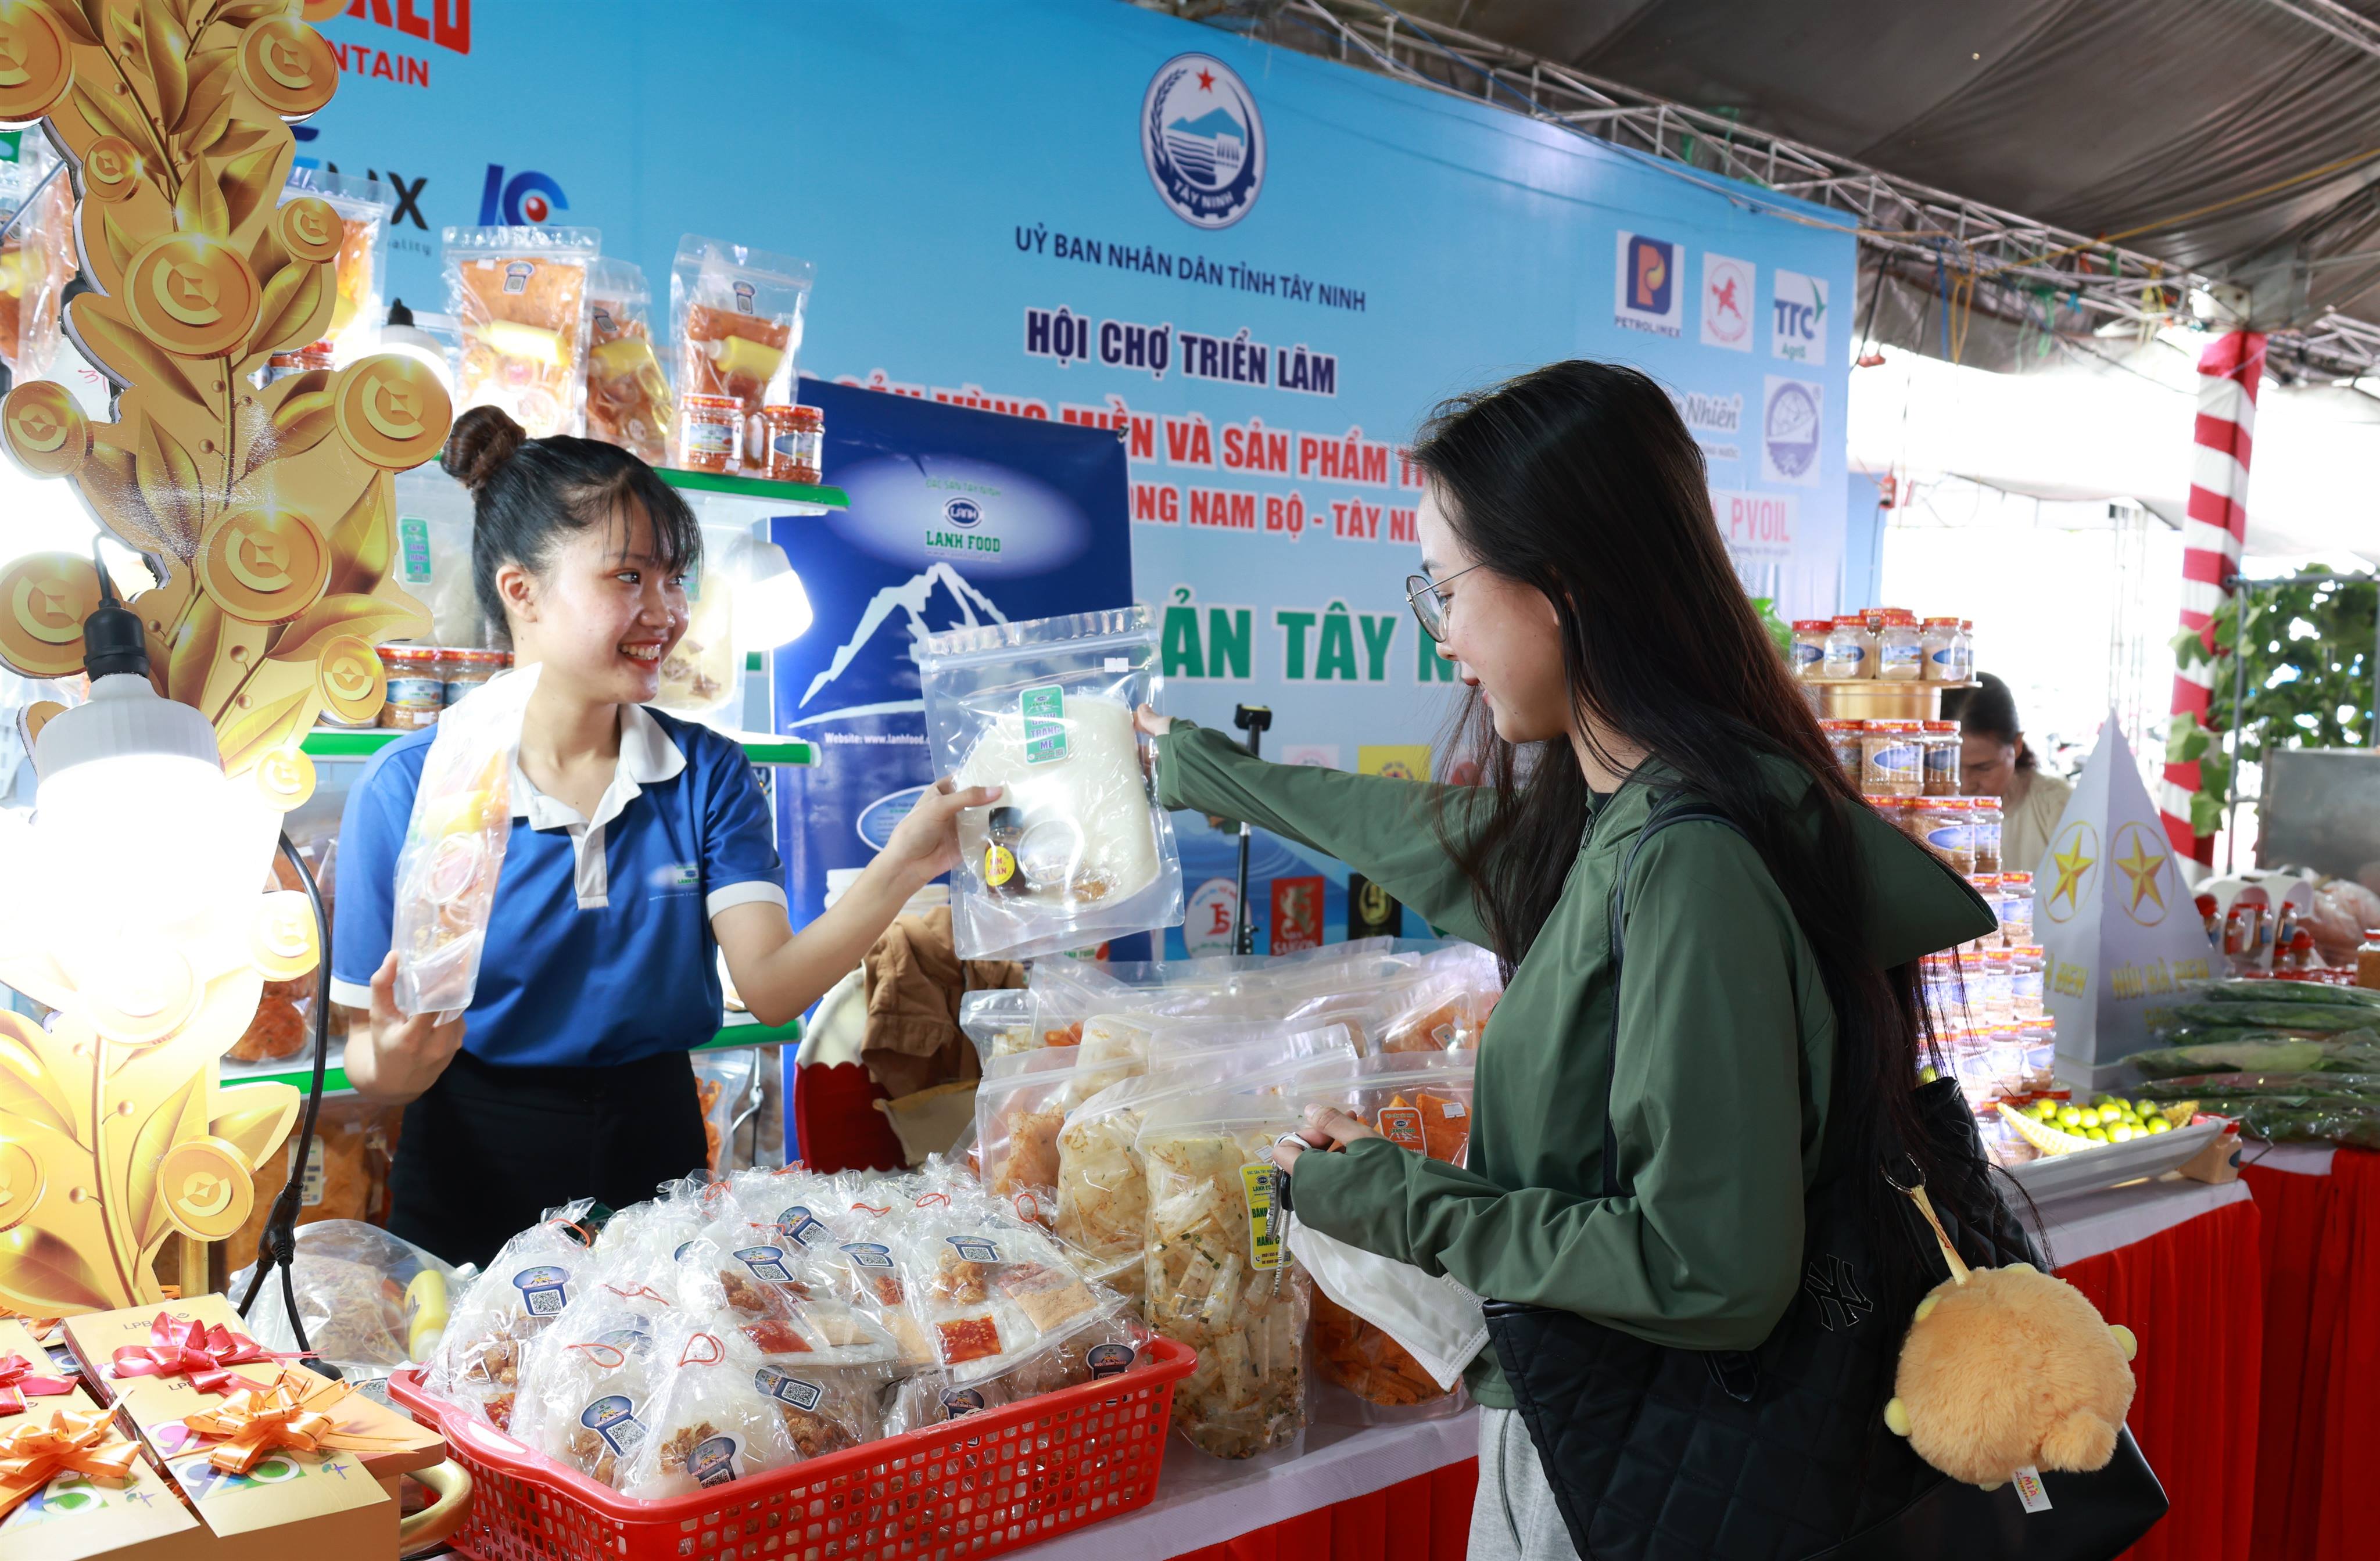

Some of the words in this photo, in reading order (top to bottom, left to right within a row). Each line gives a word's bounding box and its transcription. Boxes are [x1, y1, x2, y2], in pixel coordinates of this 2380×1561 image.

[327, 39, 429, 88] NTAIN
[1055, 234, 1102, 264] BAN
[1109, 244, 1171, 277] NHÂN
[1179, 252, 1223, 285] DÂN
[1228, 261, 1275, 296] TỈNH
[1280, 274, 1314, 303] TÂY
[1318, 283, 1365, 311] NINH
[1614, 315, 1681, 338] PETROLIMEX
[1775, 299, 1815, 340] TTC
[1028, 307, 1087, 365] HỘI
[1101, 322, 1170, 378] CHỢ
[1180, 329, 1267, 384] TRIỂN
[1279, 343, 1335, 394] LÃM
[1166, 415, 1212, 465] VÀ
[1224, 419, 1288, 472] SẢN
[1300, 429, 1387, 483] PHẨM
[1191, 490, 1255, 529] NAM
[1266, 494, 1304, 540] BỘ
[1332, 499, 1381, 538] TÂY
[1390, 510, 1420, 541] NI
[1731, 498, 1790, 543] PVOIL
[967, 534, 1001, 552] FOOD
[1161, 588, 1251, 677] ẢN
[1277, 601, 1397, 680] TÂY
[123, 1320, 152, 1330] LPB
